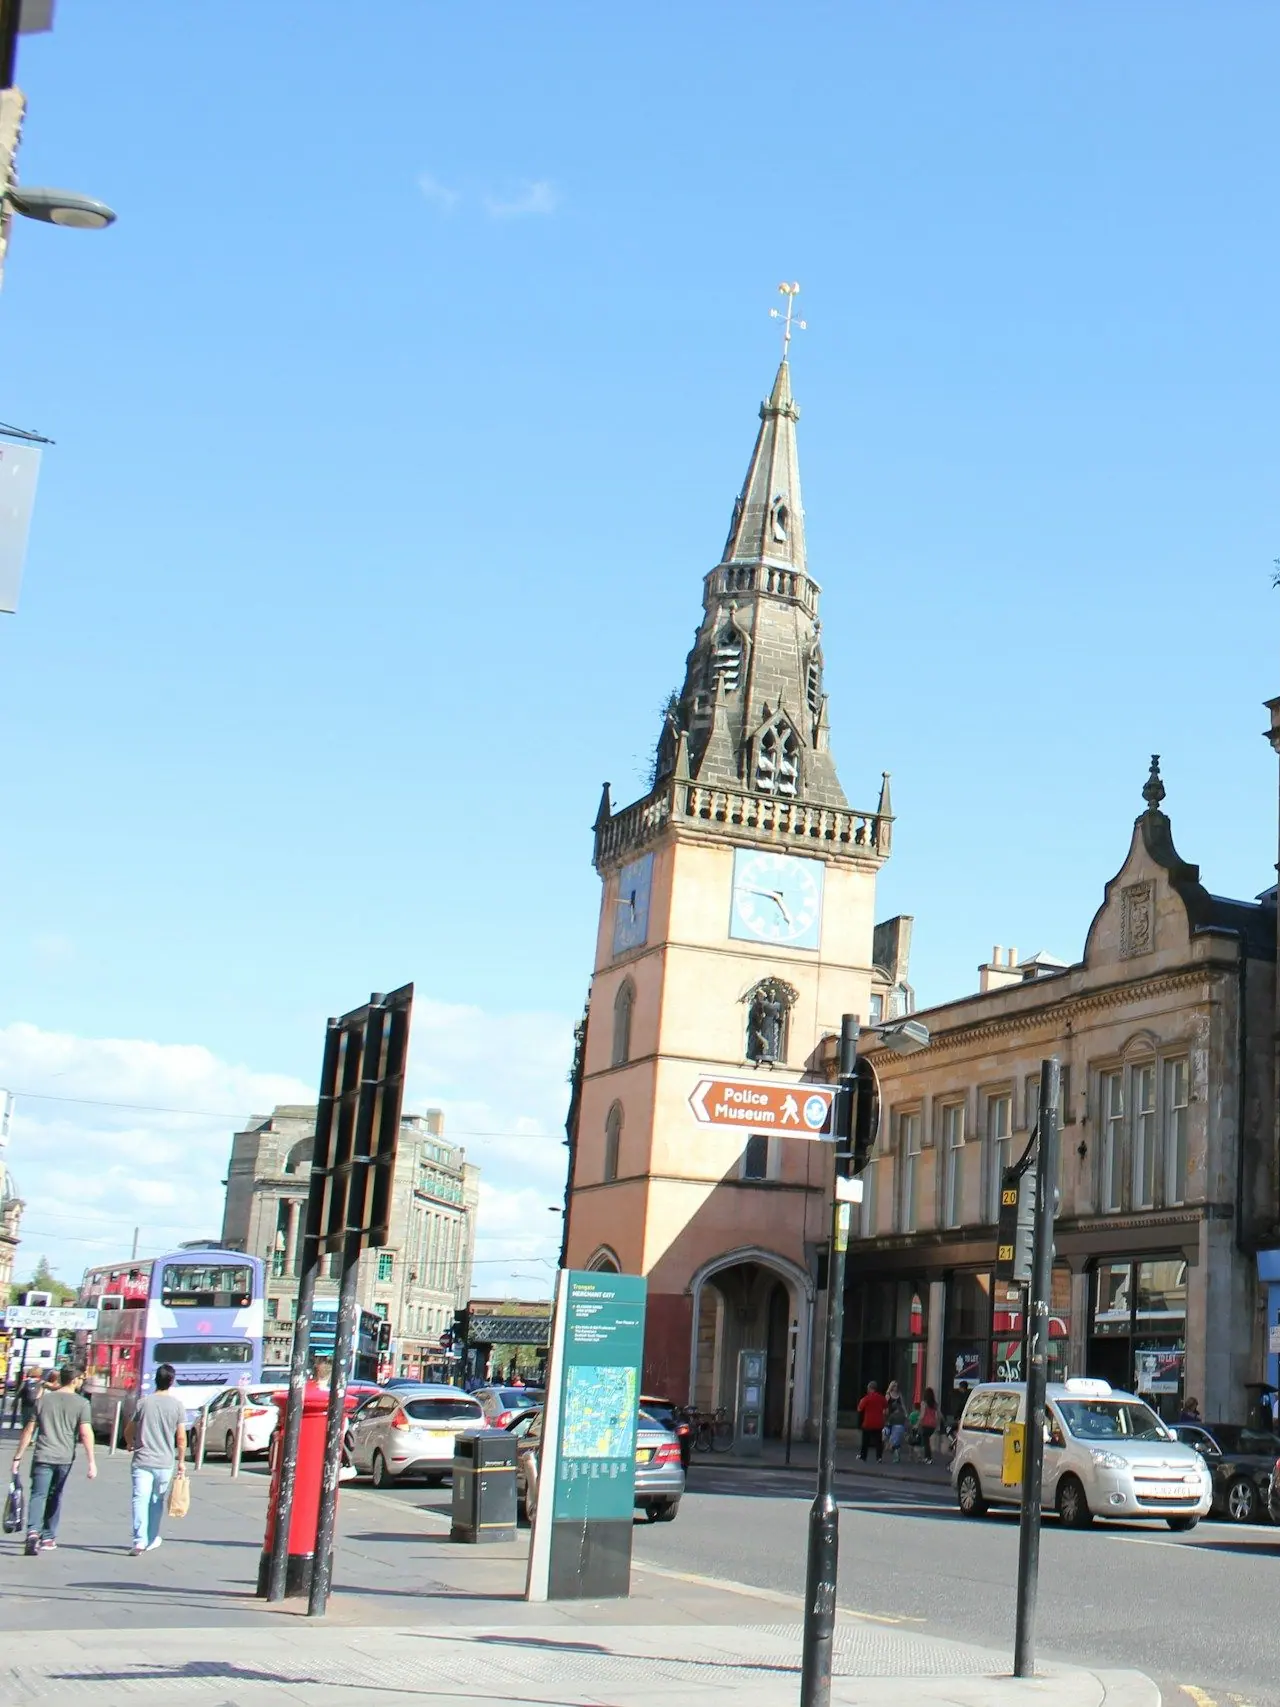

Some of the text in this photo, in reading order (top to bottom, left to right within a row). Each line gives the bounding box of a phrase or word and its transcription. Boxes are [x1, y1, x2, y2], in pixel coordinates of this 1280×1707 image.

[724, 1088, 769, 1105] Police
[714, 1104, 775, 1122] Museum
[1004, 1192, 1016, 1203] 20
[1000, 1247, 1011, 1259] 21
